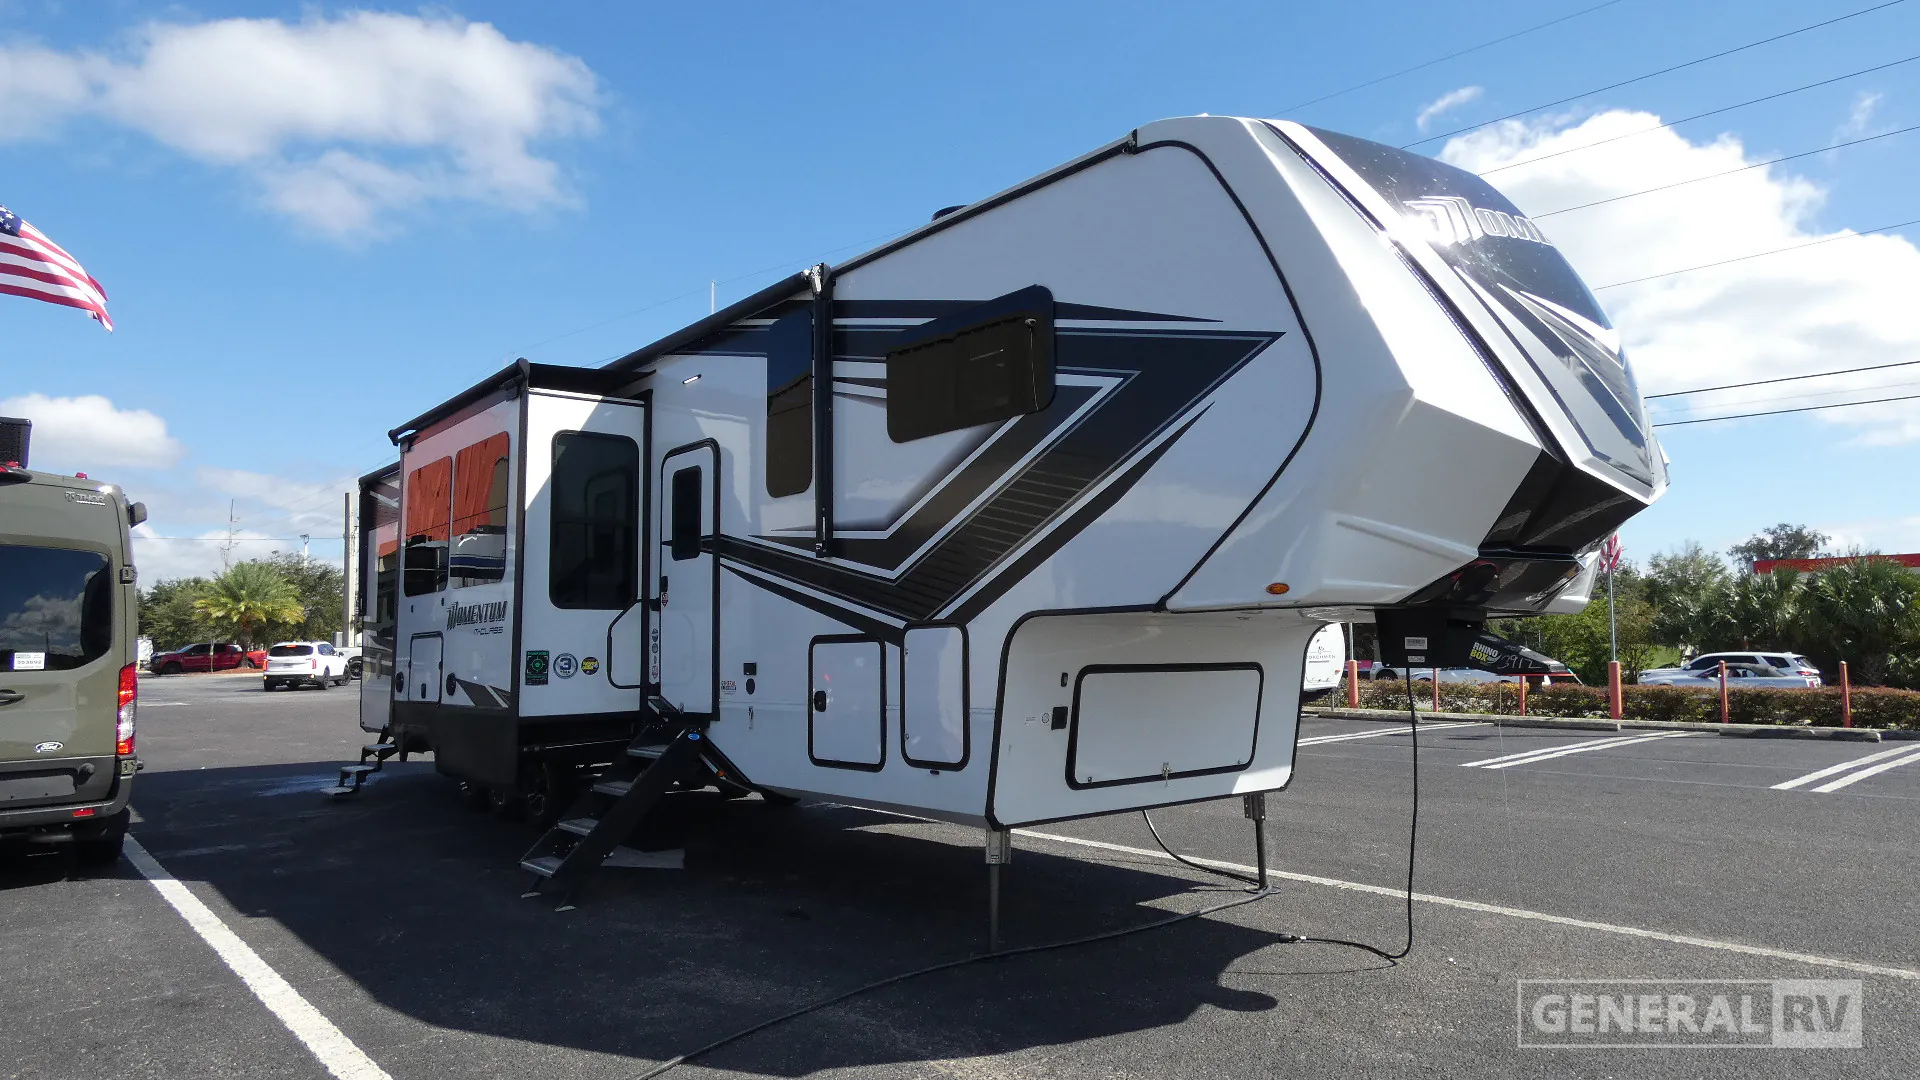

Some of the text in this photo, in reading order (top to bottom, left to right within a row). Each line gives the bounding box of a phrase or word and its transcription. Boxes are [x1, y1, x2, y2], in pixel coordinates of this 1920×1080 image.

[446, 600, 508, 631] MOMENTUM
[1470, 649, 1489, 662] BOX
[1472, 641, 1499, 658] RHINO
[560, 657, 572, 671] 3
